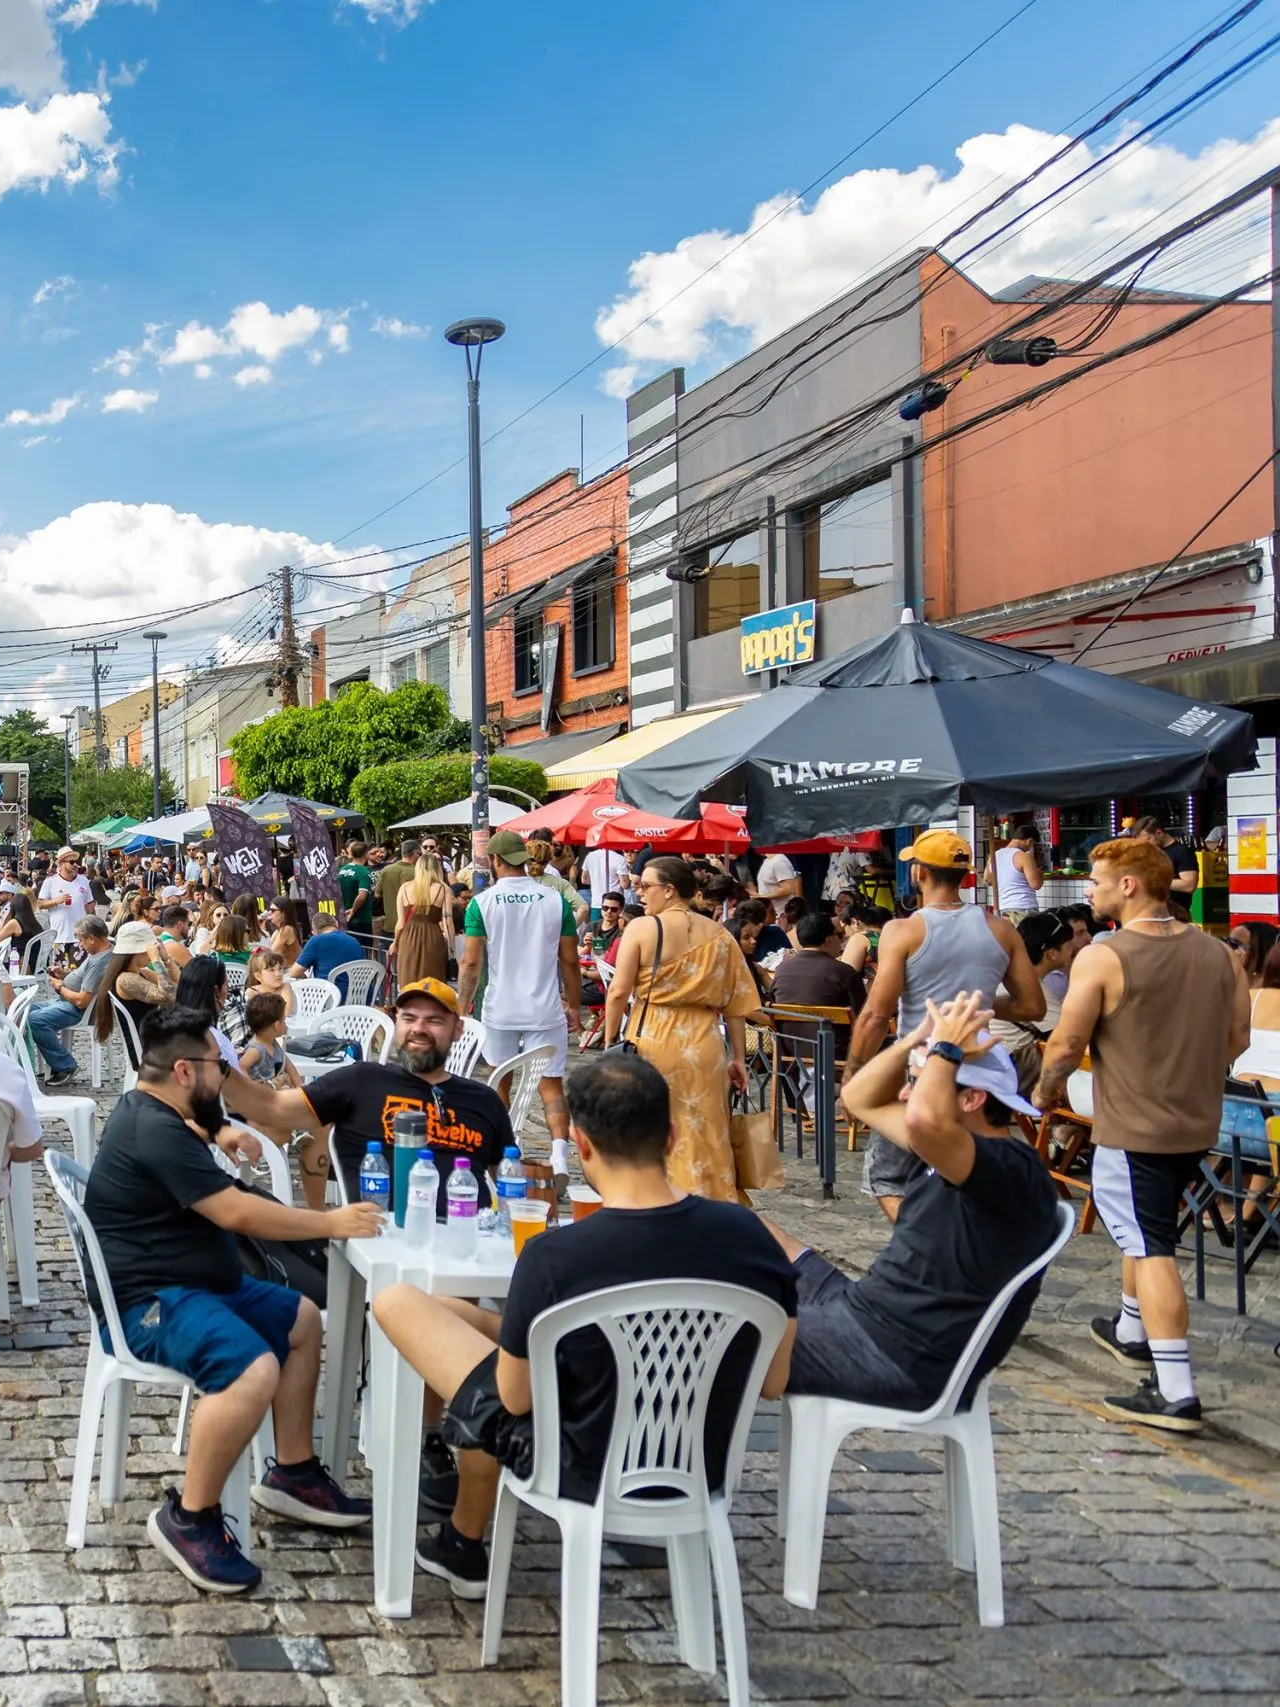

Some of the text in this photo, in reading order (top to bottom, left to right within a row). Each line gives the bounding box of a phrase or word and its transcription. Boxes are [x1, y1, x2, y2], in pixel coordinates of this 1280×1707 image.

[811, 780, 860, 792] SOMEWHERE
[495, 893, 536, 904] Fictor
[426, 1118, 483, 1148] twelve
